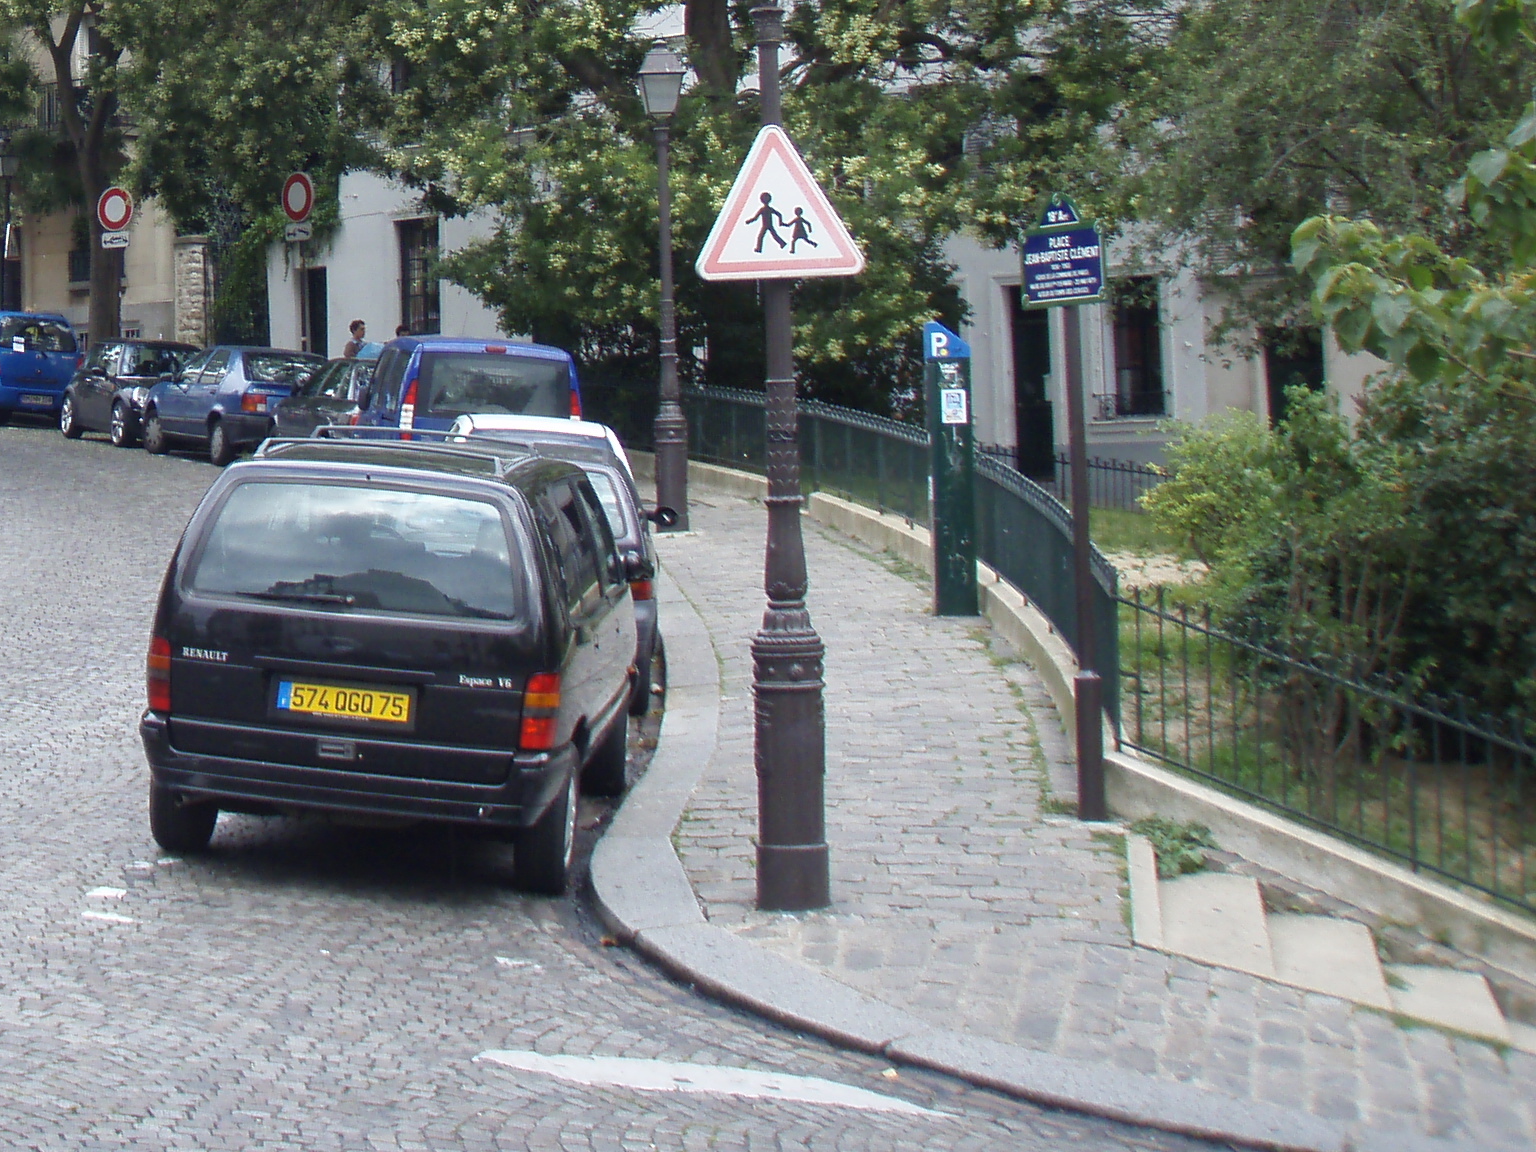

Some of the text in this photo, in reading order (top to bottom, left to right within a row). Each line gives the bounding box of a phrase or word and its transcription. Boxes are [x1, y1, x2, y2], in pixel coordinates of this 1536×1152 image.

[1048, 235, 1071, 249] PLACE
[930, 332, 948, 357] P
[182, 646, 229, 662] RENAULT
[458, 674, 512, 689] Espace V6
[292, 687, 330, 710] 574
[335, 690, 374, 715] QGQ
[378, 694, 405, 718] 75
